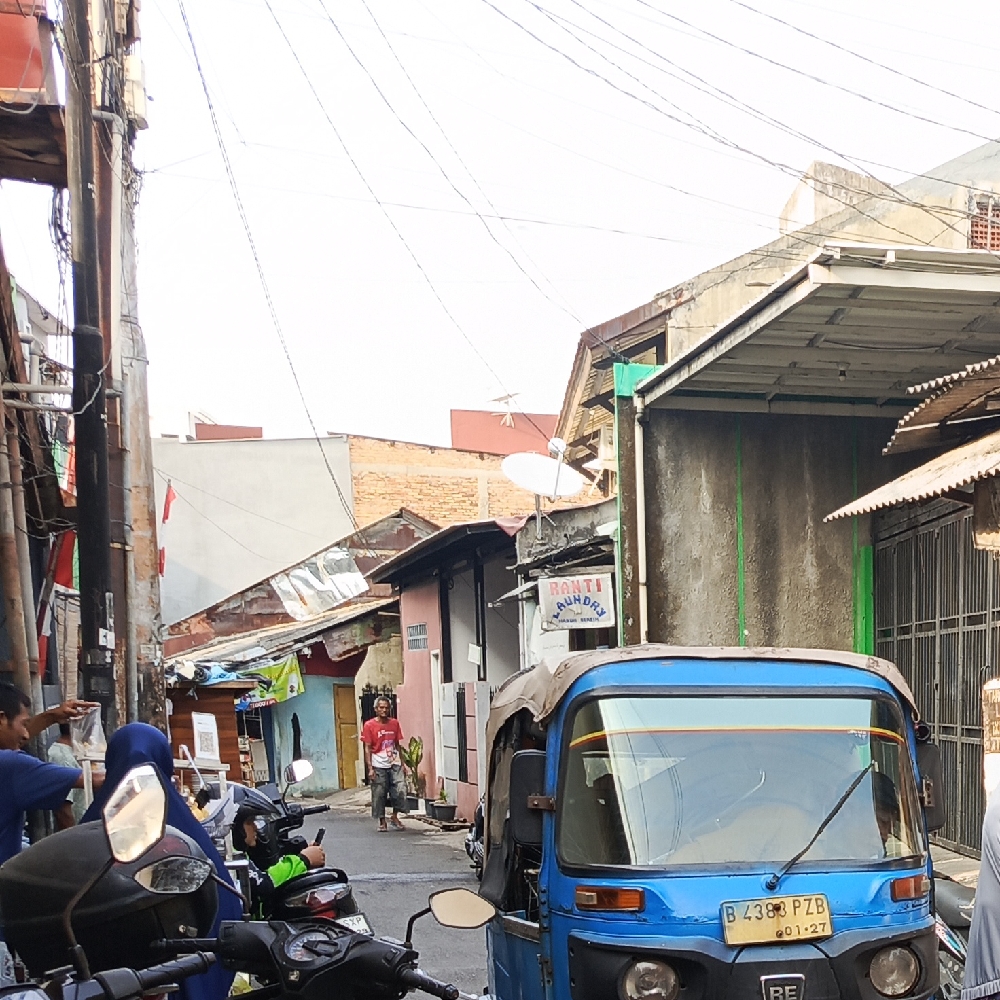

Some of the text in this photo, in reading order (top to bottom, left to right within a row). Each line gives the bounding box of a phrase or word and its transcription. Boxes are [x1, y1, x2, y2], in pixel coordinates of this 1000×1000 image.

[549, 578, 602, 596] RANTI
[552, 595, 607, 619] LAUNDRY
[725, 905, 737, 923] B
[792, 897, 826, 916] PZB
